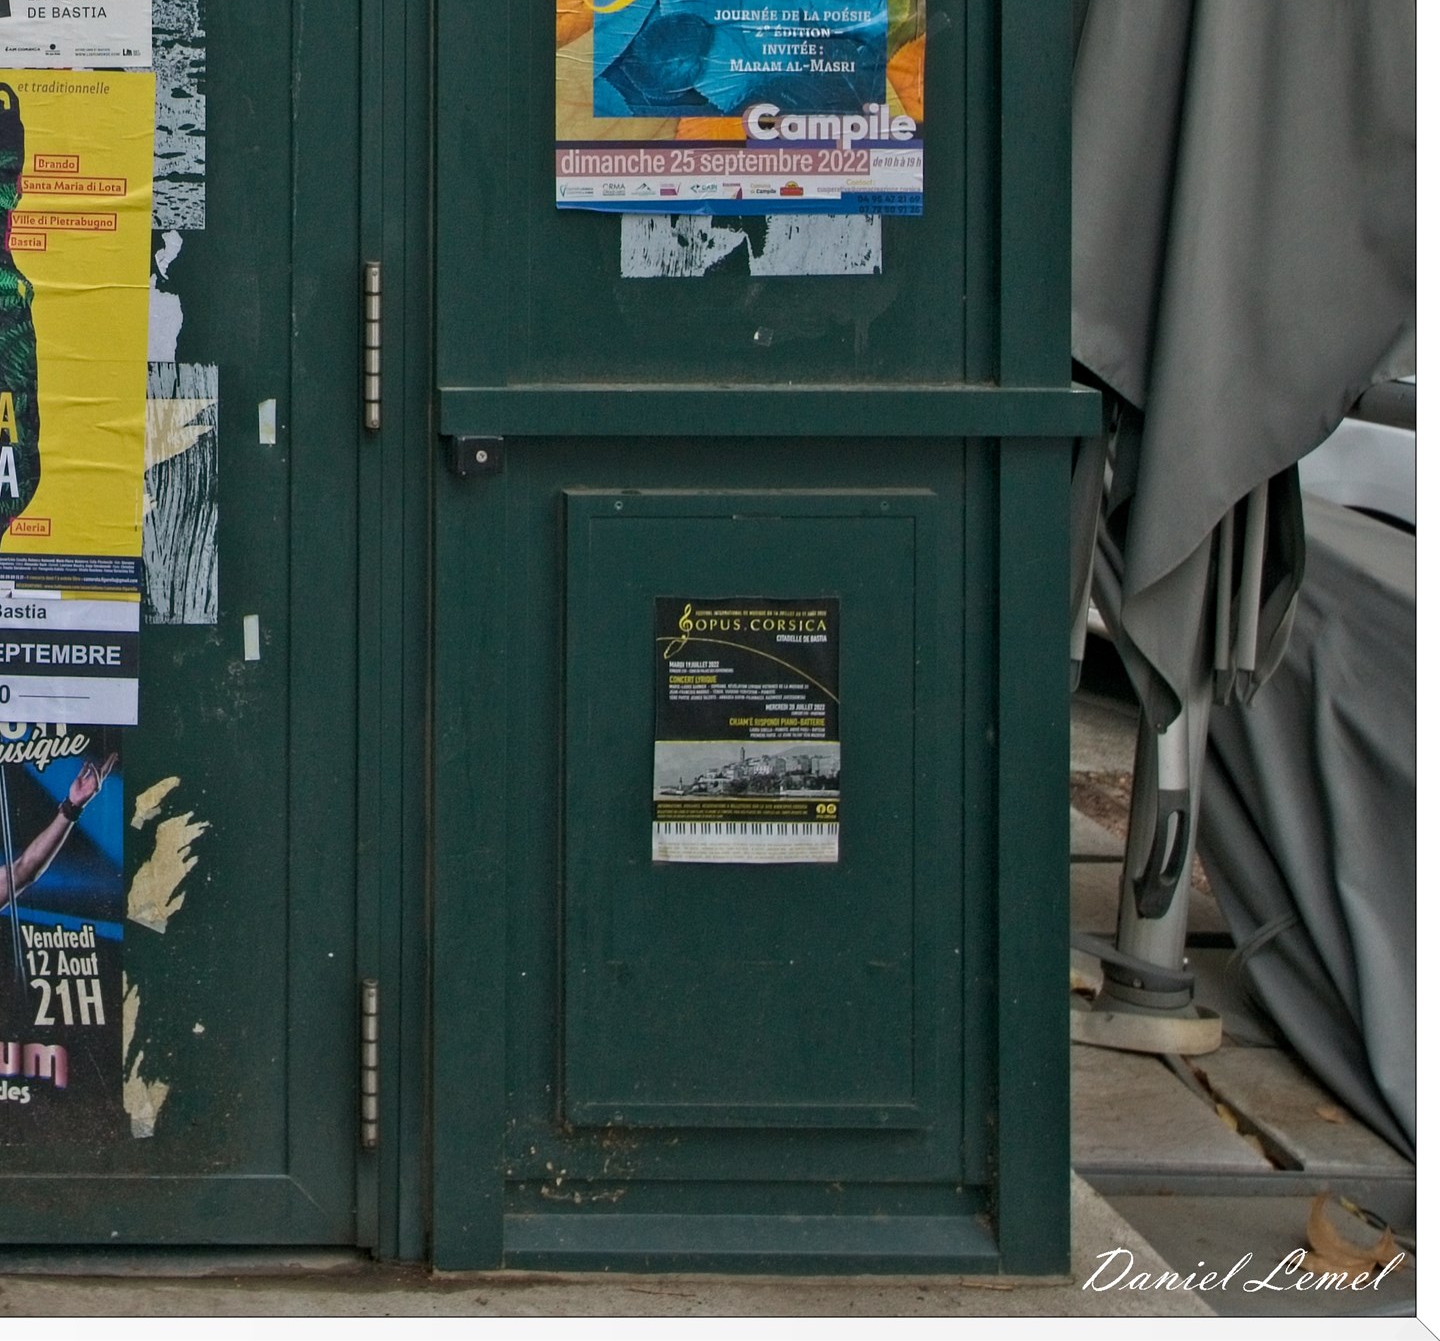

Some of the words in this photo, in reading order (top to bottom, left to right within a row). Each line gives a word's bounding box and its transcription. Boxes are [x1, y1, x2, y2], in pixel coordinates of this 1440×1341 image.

[27, 6, 47, 18] DE
[52, 6, 107, 18] BASTIA
[714, 7, 779, 22] JOURNÉE
[782, 9, 800, 21] DE
[802, 8, 821, 21] LA
[824, 7, 872, 23] POÉSIE
[17, 82, 29, 93] et
[31, 82, 110, 95] traditionnelle
[746, 103, 917, 149] Campile
[38, 159, 75, 170] Brando
[560, 150, 665, 174] dimanche
[670, 150, 695, 174] 25
[700, 150, 813, 176] septembre
[818, 150, 868, 174] 2022
[23, 180, 52, 191] Santa
[54, 181, 83, 192] Maria
[87, 181, 97, 192] di
[98, 182, 121, 193] Lota
[13, 215, 36, 226] Ville
[37, 215, 47, 226] di
[49, 216, 113, 229] Pietrabugno
[11, 236, 42, 247] Bastia
[15, 522, 46, 533] Aleria
